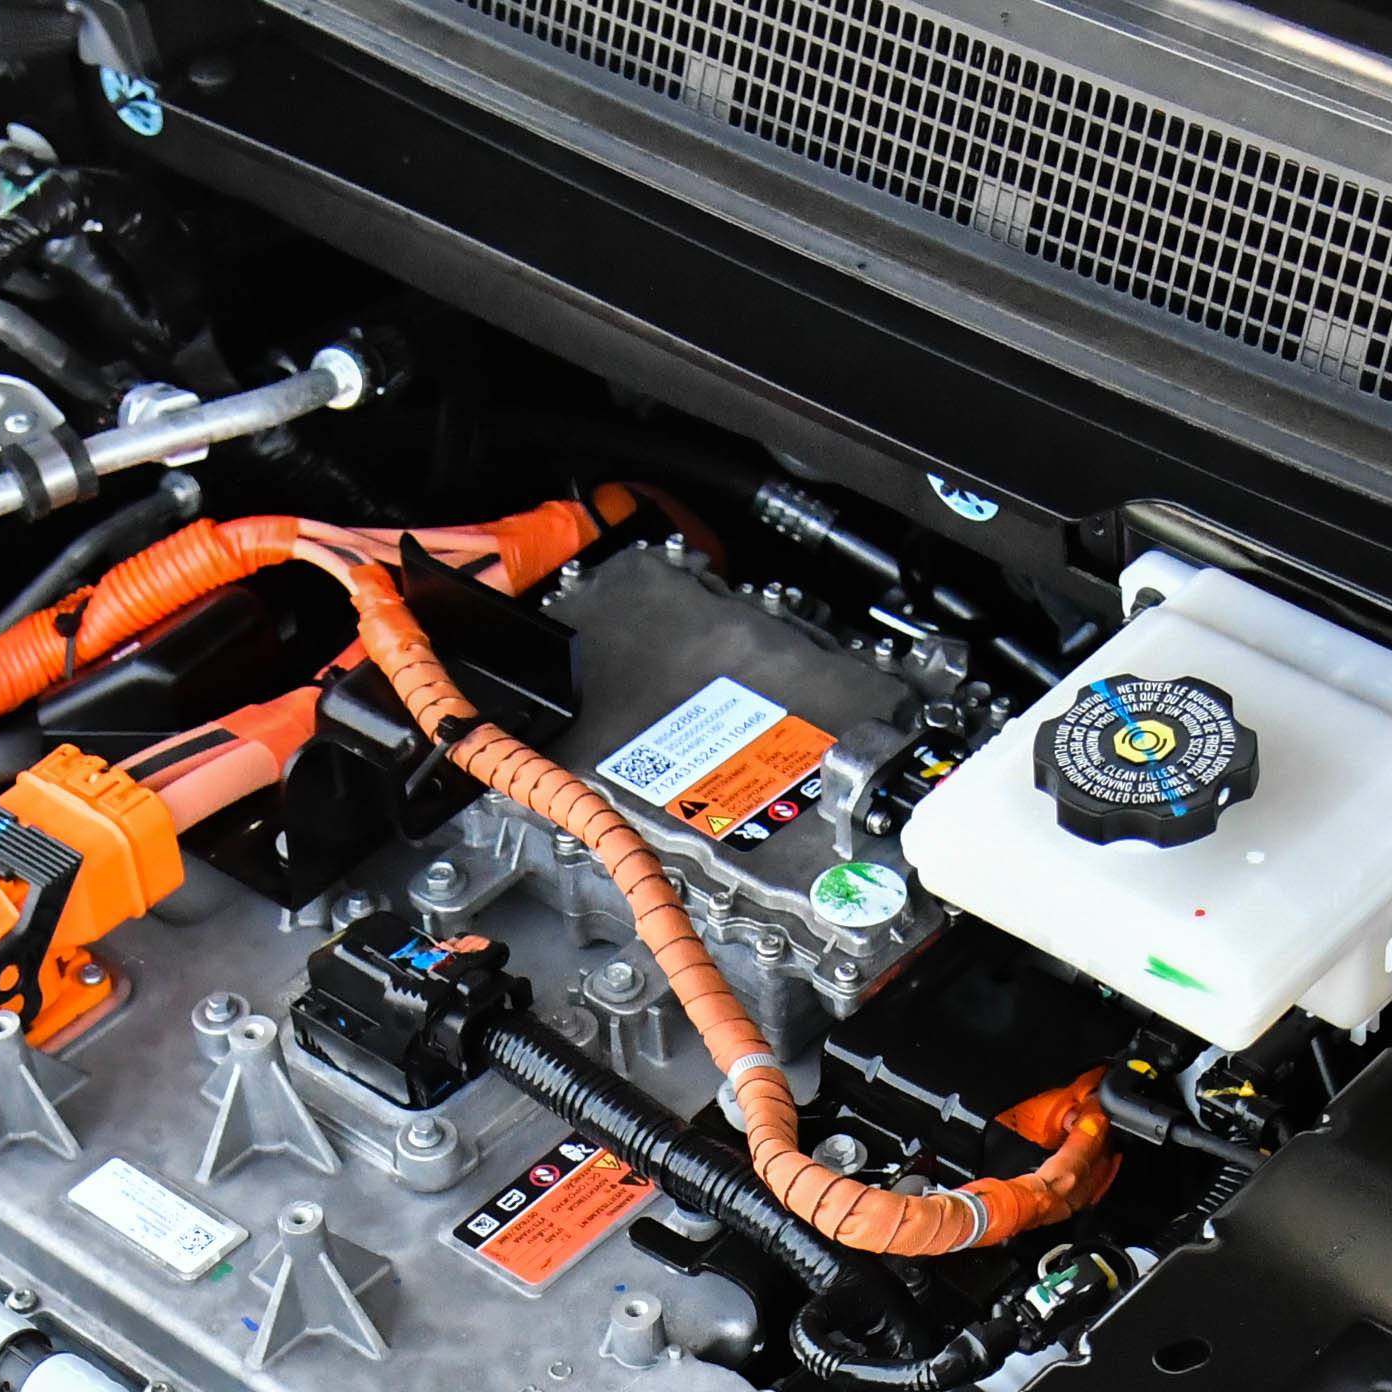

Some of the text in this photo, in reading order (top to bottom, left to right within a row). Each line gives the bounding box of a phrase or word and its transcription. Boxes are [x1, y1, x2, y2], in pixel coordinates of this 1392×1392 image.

[1116, 681, 1171, 694] NETTOYER
[1139, 692, 1159, 702] QUE
[1173, 683, 1188, 695] LE
[1163, 693, 1177, 705] DU
[1189, 689, 1227, 721] BOUCHON
[1155, 703, 1183, 719] D'UN
[1178, 698, 1213, 723] LIQUIDE
[1070, 723, 1086, 744] CAP
[1179, 711, 1201, 737] BIDON
[1204, 722, 1218, 734] DE
[1218, 719, 1236, 743] AVANT
[1053, 723, 1072, 748] DOT4
[1205, 733, 1217, 757] FREIN
[1053, 746, 1069, 768] FLUID
[1069, 742, 1089, 773] BEFORE
[1176, 735, 1201, 767] SCELLE
[1223, 744, 1236, 755] LA
[1061, 764, 1086, 788] FROM
[1103, 764, 1138, 781] CLEAN
[1138, 766, 1179, 781] FILLER
[1187, 755, 1214, 776] DOT4
[1196, 754, 1231, 786] DEPOSE
[1082, 783, 1091, 795] A
[1137, 781, 1158, 792] USE
[1160, 773, 1188, 791] ONLY
[1089, 786, 1130, 804] SEALED
[548, 1360, 574, 1381] C
